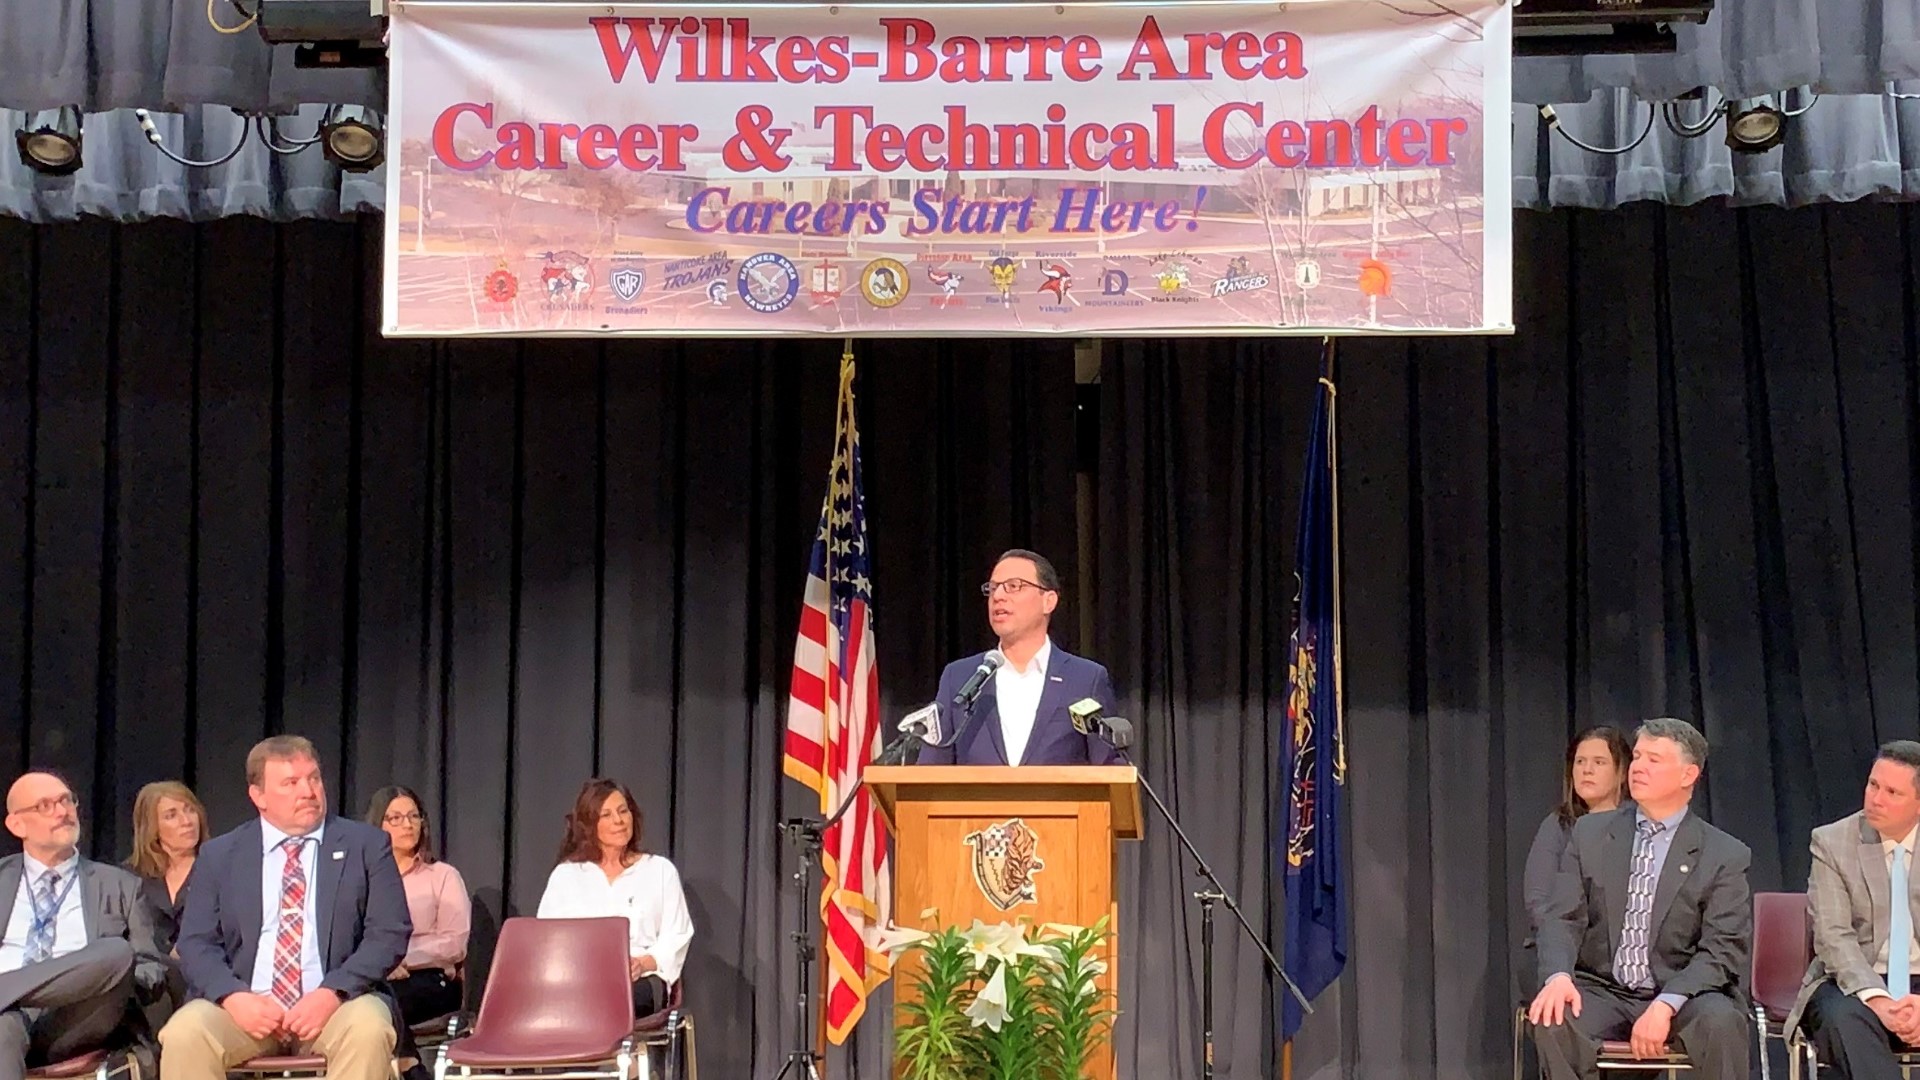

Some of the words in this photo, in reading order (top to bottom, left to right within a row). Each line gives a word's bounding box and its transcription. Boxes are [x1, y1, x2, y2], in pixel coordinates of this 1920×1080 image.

[589, 16, 1103, 84] Wilkes-Barre
[1117, 15, 1307, 82] Area
[432, 102, 698, 172] Career
[722, 104, 793, 172] &
[814, 104, 1178, 173] Technical
[1203, 101, 1468, 171] Center
[686, 186, 890, 237] Careers
[906, 186, 1036, 236] Start
[1047, 184, 1208, 234] Here!
[708, 250, 728, 262] AREA
[740, 254, 775, 280] HANOVER
[778, 255, 797, 280] AREA
[616, 272, 638, 296] GAR
[662, 260, 734, 290] TROJANS
[1211, 275, 1269, 298] RANGERS
[744, 293, 793, 311] HAWKEYES
